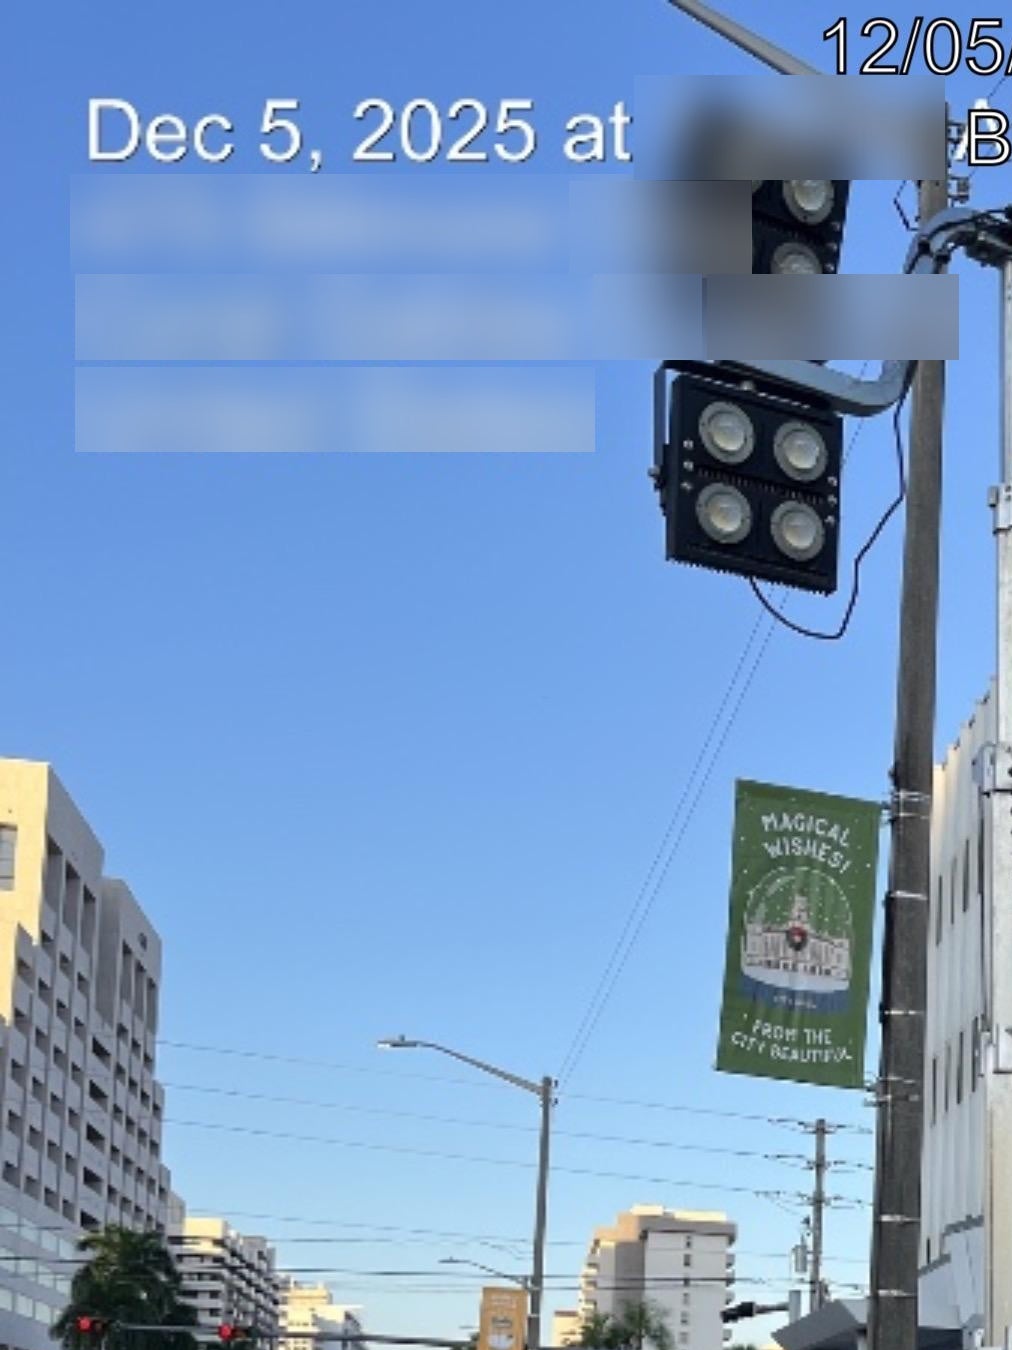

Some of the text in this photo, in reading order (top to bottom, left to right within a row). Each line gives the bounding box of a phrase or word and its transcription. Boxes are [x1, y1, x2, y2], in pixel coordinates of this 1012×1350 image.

[760, 812, 850, 848] MAGICAL
[761, 836, 852, 875] WISHES!
[731, 1030, 853, 1064] CITY BEAUTIFUL
[752, 1019, 833, 1046] FROM THE
